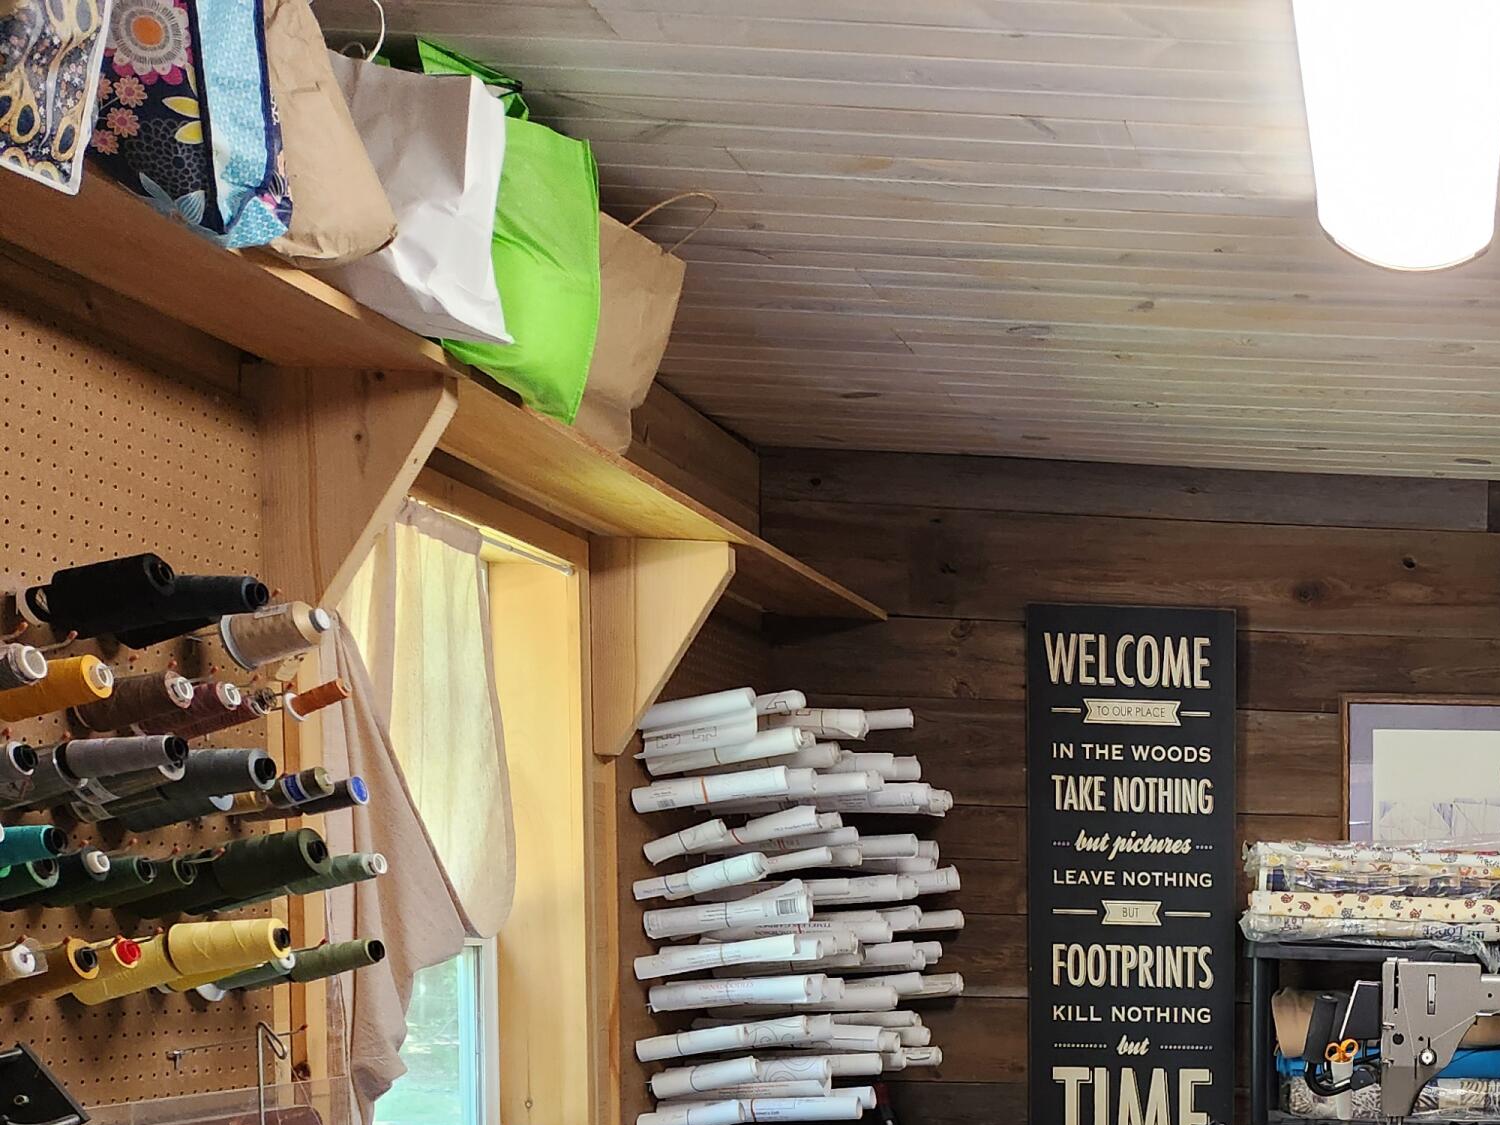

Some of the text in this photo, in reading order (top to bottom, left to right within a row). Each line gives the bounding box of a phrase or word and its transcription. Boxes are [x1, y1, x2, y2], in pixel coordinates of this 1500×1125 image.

[1044, 632, 1211, 688] WELCOME
[1097, 705, 1166, 718] TO OUR PLACE
[1053, 743, 1211, 762] IN THE WOODS
[1051, 775, 1214, 815] TAKE NOTHING
[1075, 829, 1192, 860] but pictures
[1053, 870, 1213, 888] LEAVE NOTHING
[1122, 907, 1139, 918] BUT
[1052, 943, 1214, 990] FOOTPRINTS
[1053, 1005, 1212, 1024] KILL NOTHING
[1117, 1034, 1150, 1056] but
